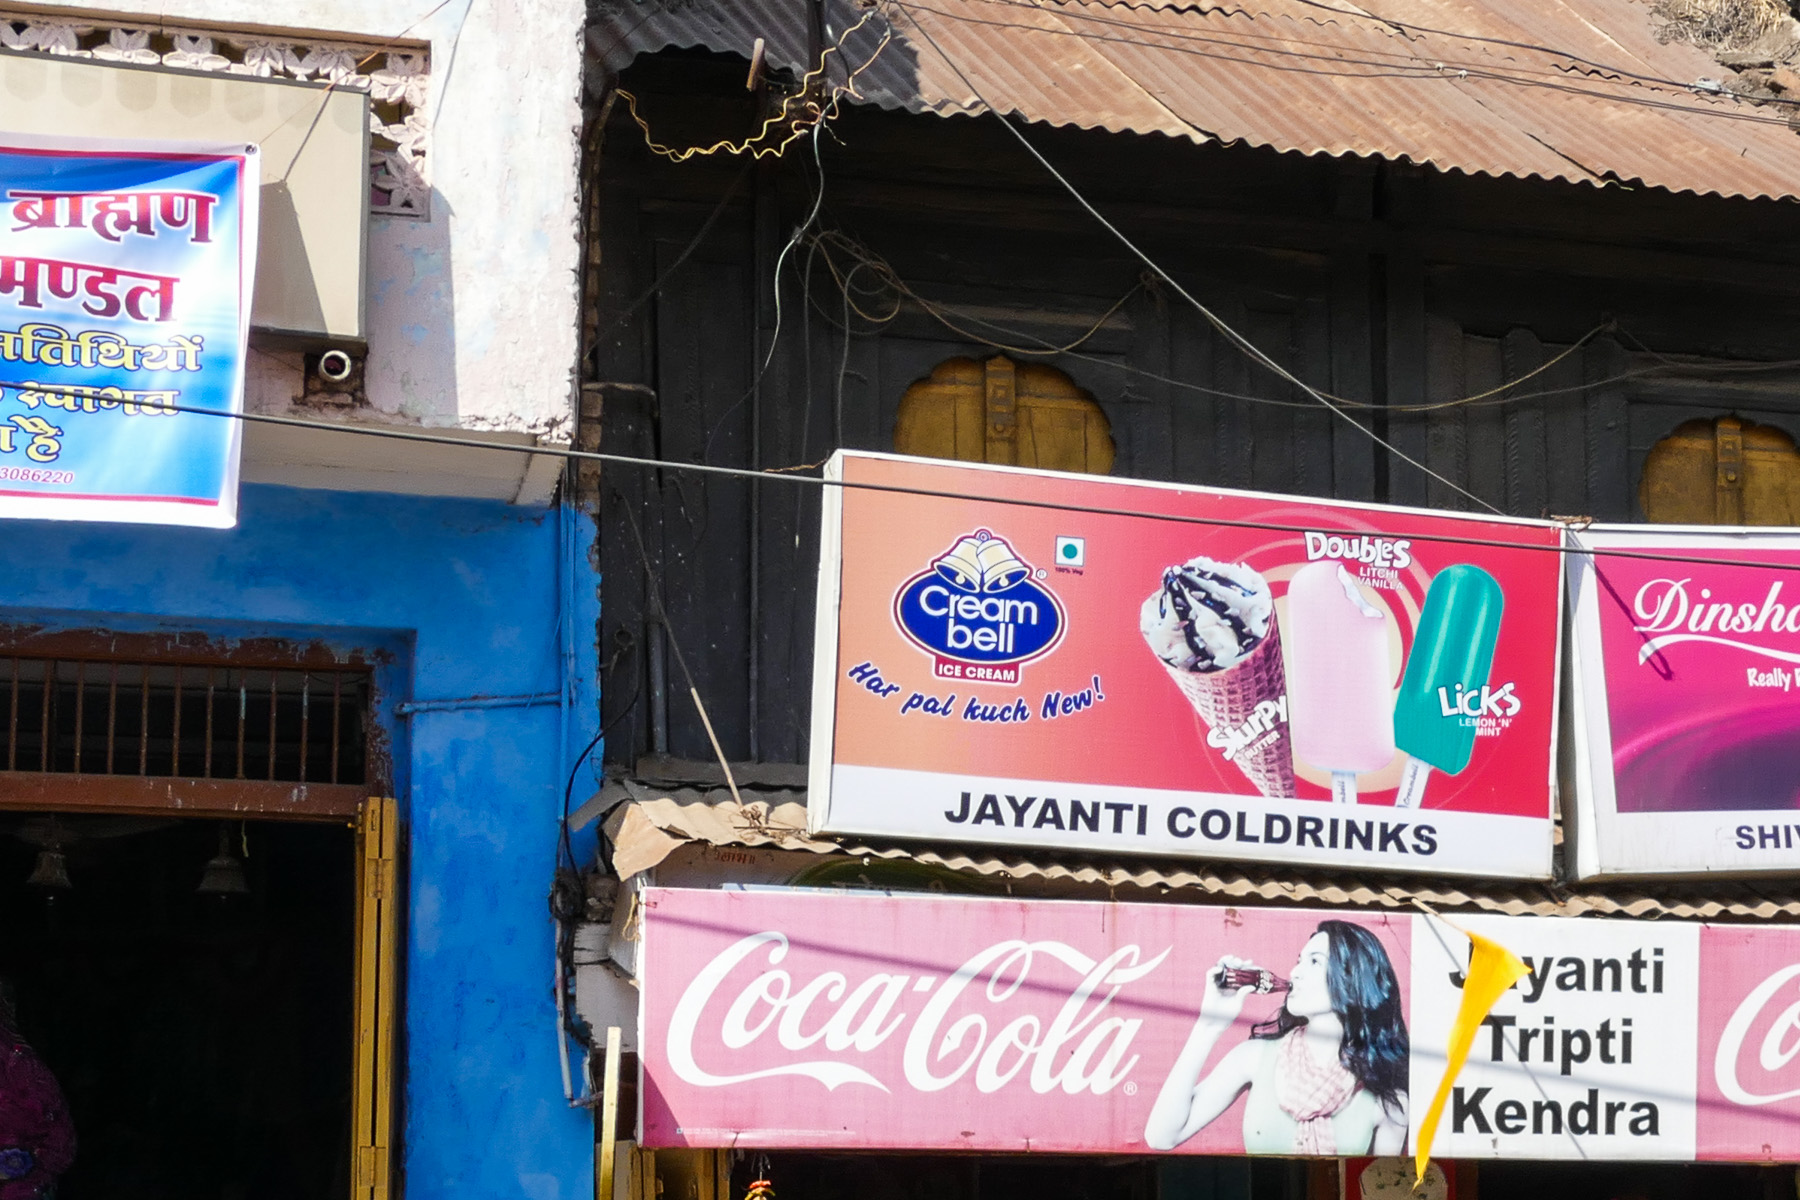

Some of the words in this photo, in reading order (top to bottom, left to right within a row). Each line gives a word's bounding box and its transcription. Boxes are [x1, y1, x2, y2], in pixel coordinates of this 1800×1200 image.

[9, 190, 218, 243] ब्राह्मण
[1357, 577, 1405, 591] VANILLA
[1359, 566, 1399, 580] LITCHI
[919, 585, 1038, 626] Cream
[947, 617, 1014, 653] bell
[848, 661, 901, 698] Har
[901, 691, 956, 715] pal
[963, 697, 1031, 722] kuch
[1041, 675, 1105, 718] New!
[938, 664, 962, 677] ICE
[965, 666, 1016, 682] CREAM
[1746, 667, 1792, 693] Really
[1458, 717, 1497, 728] LEMON
[1475, 727, 1502, 738] MINT
[944, 791, 1149, 836] JAYANTI
[1166, 805, 1439, 858] COLDRINKS
[665, 930, 1175, 1096] Coca-Cola
[1480, 1015, 1633, 1076] Tripti
[1452, 1086, 1661, 1137] Kendra
